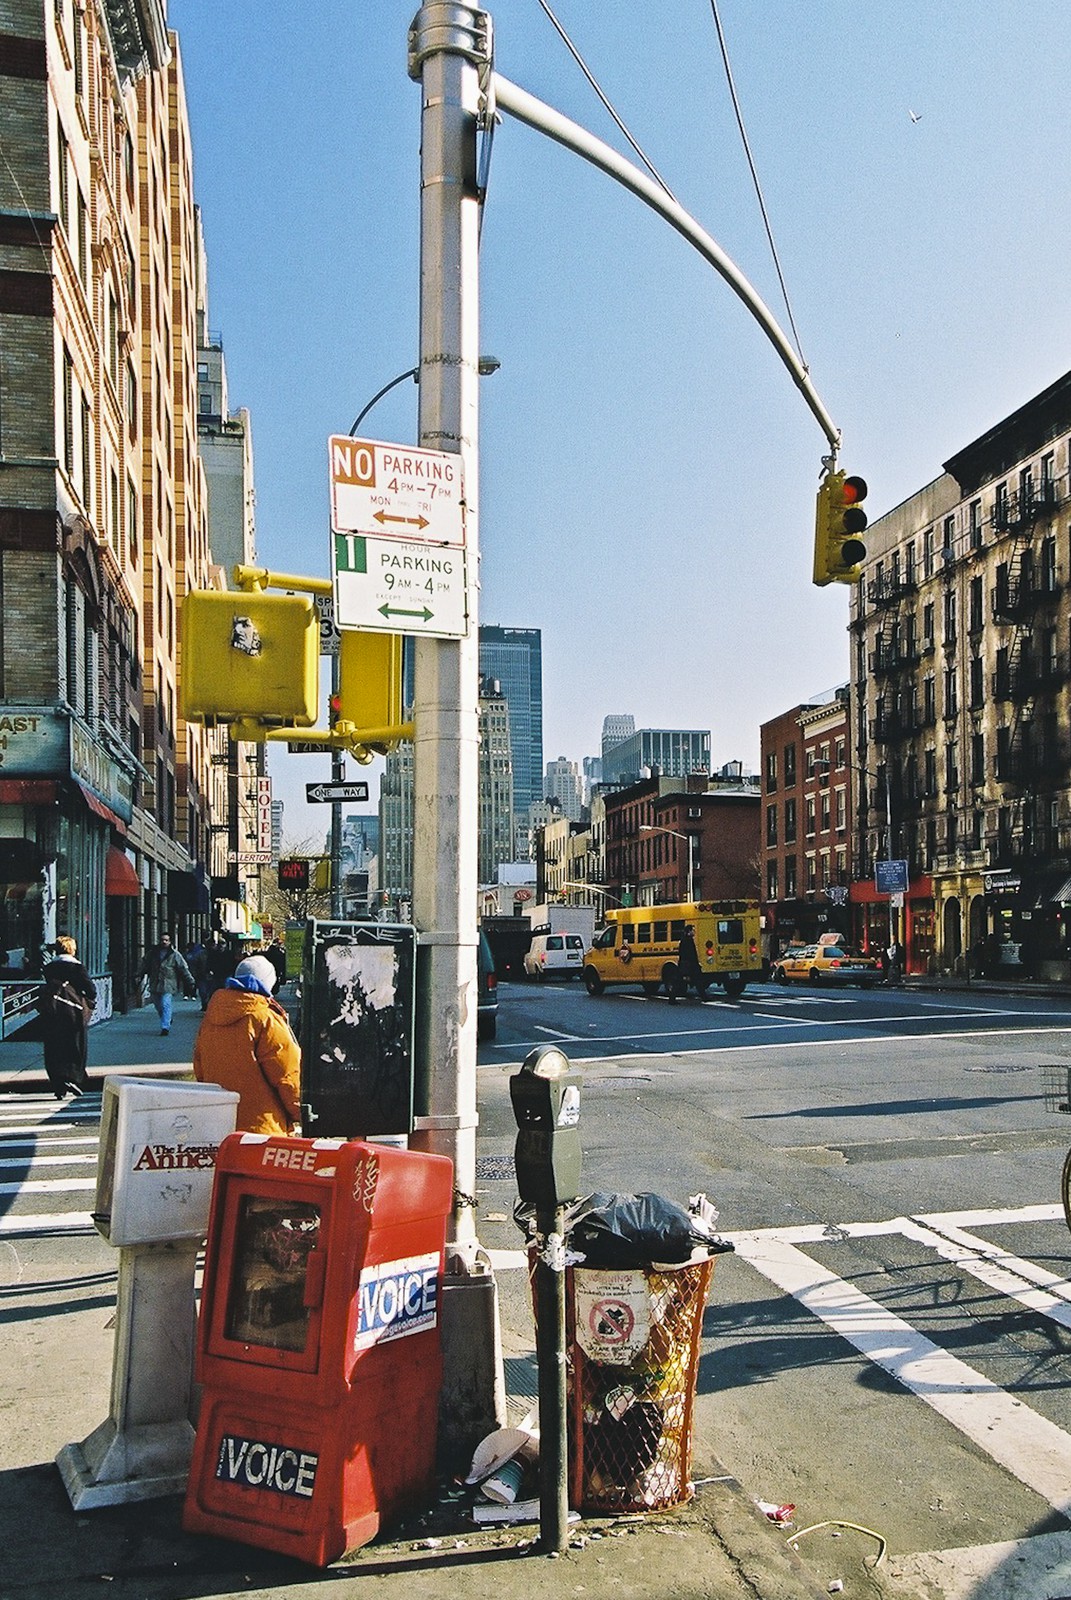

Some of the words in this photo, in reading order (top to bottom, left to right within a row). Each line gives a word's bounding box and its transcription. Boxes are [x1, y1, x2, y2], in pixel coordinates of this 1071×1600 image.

[334, 445, 373, 480] NO
[383, 454, 453, 481] PARKING
[370, 495, 391, 506] MON
[345, 535, 356, 569] 1
[401, 544, 431, 554] HOUR
[380, 553, 453, 574] PARKING
[375, 593, 401, 601] EXCEPT
[409, 596, 434, 604] SUNDAY
[320, 619, 341, 638] 3
[314, 788, 333, 798] ONE
[343, 788, 361, 797] WAY
[258, 780, 270, 849] HOTEL
[229, 853, 272, 862] ALERTON
[153, 1145, 175, 1154] The
[177, 1143, 219, 1154] Learnin
[262, 1147, 318, 1171] FREE
[363, 1271, 437, 1328] VOICE
[228, 1438, 318, 1496] VOICE
